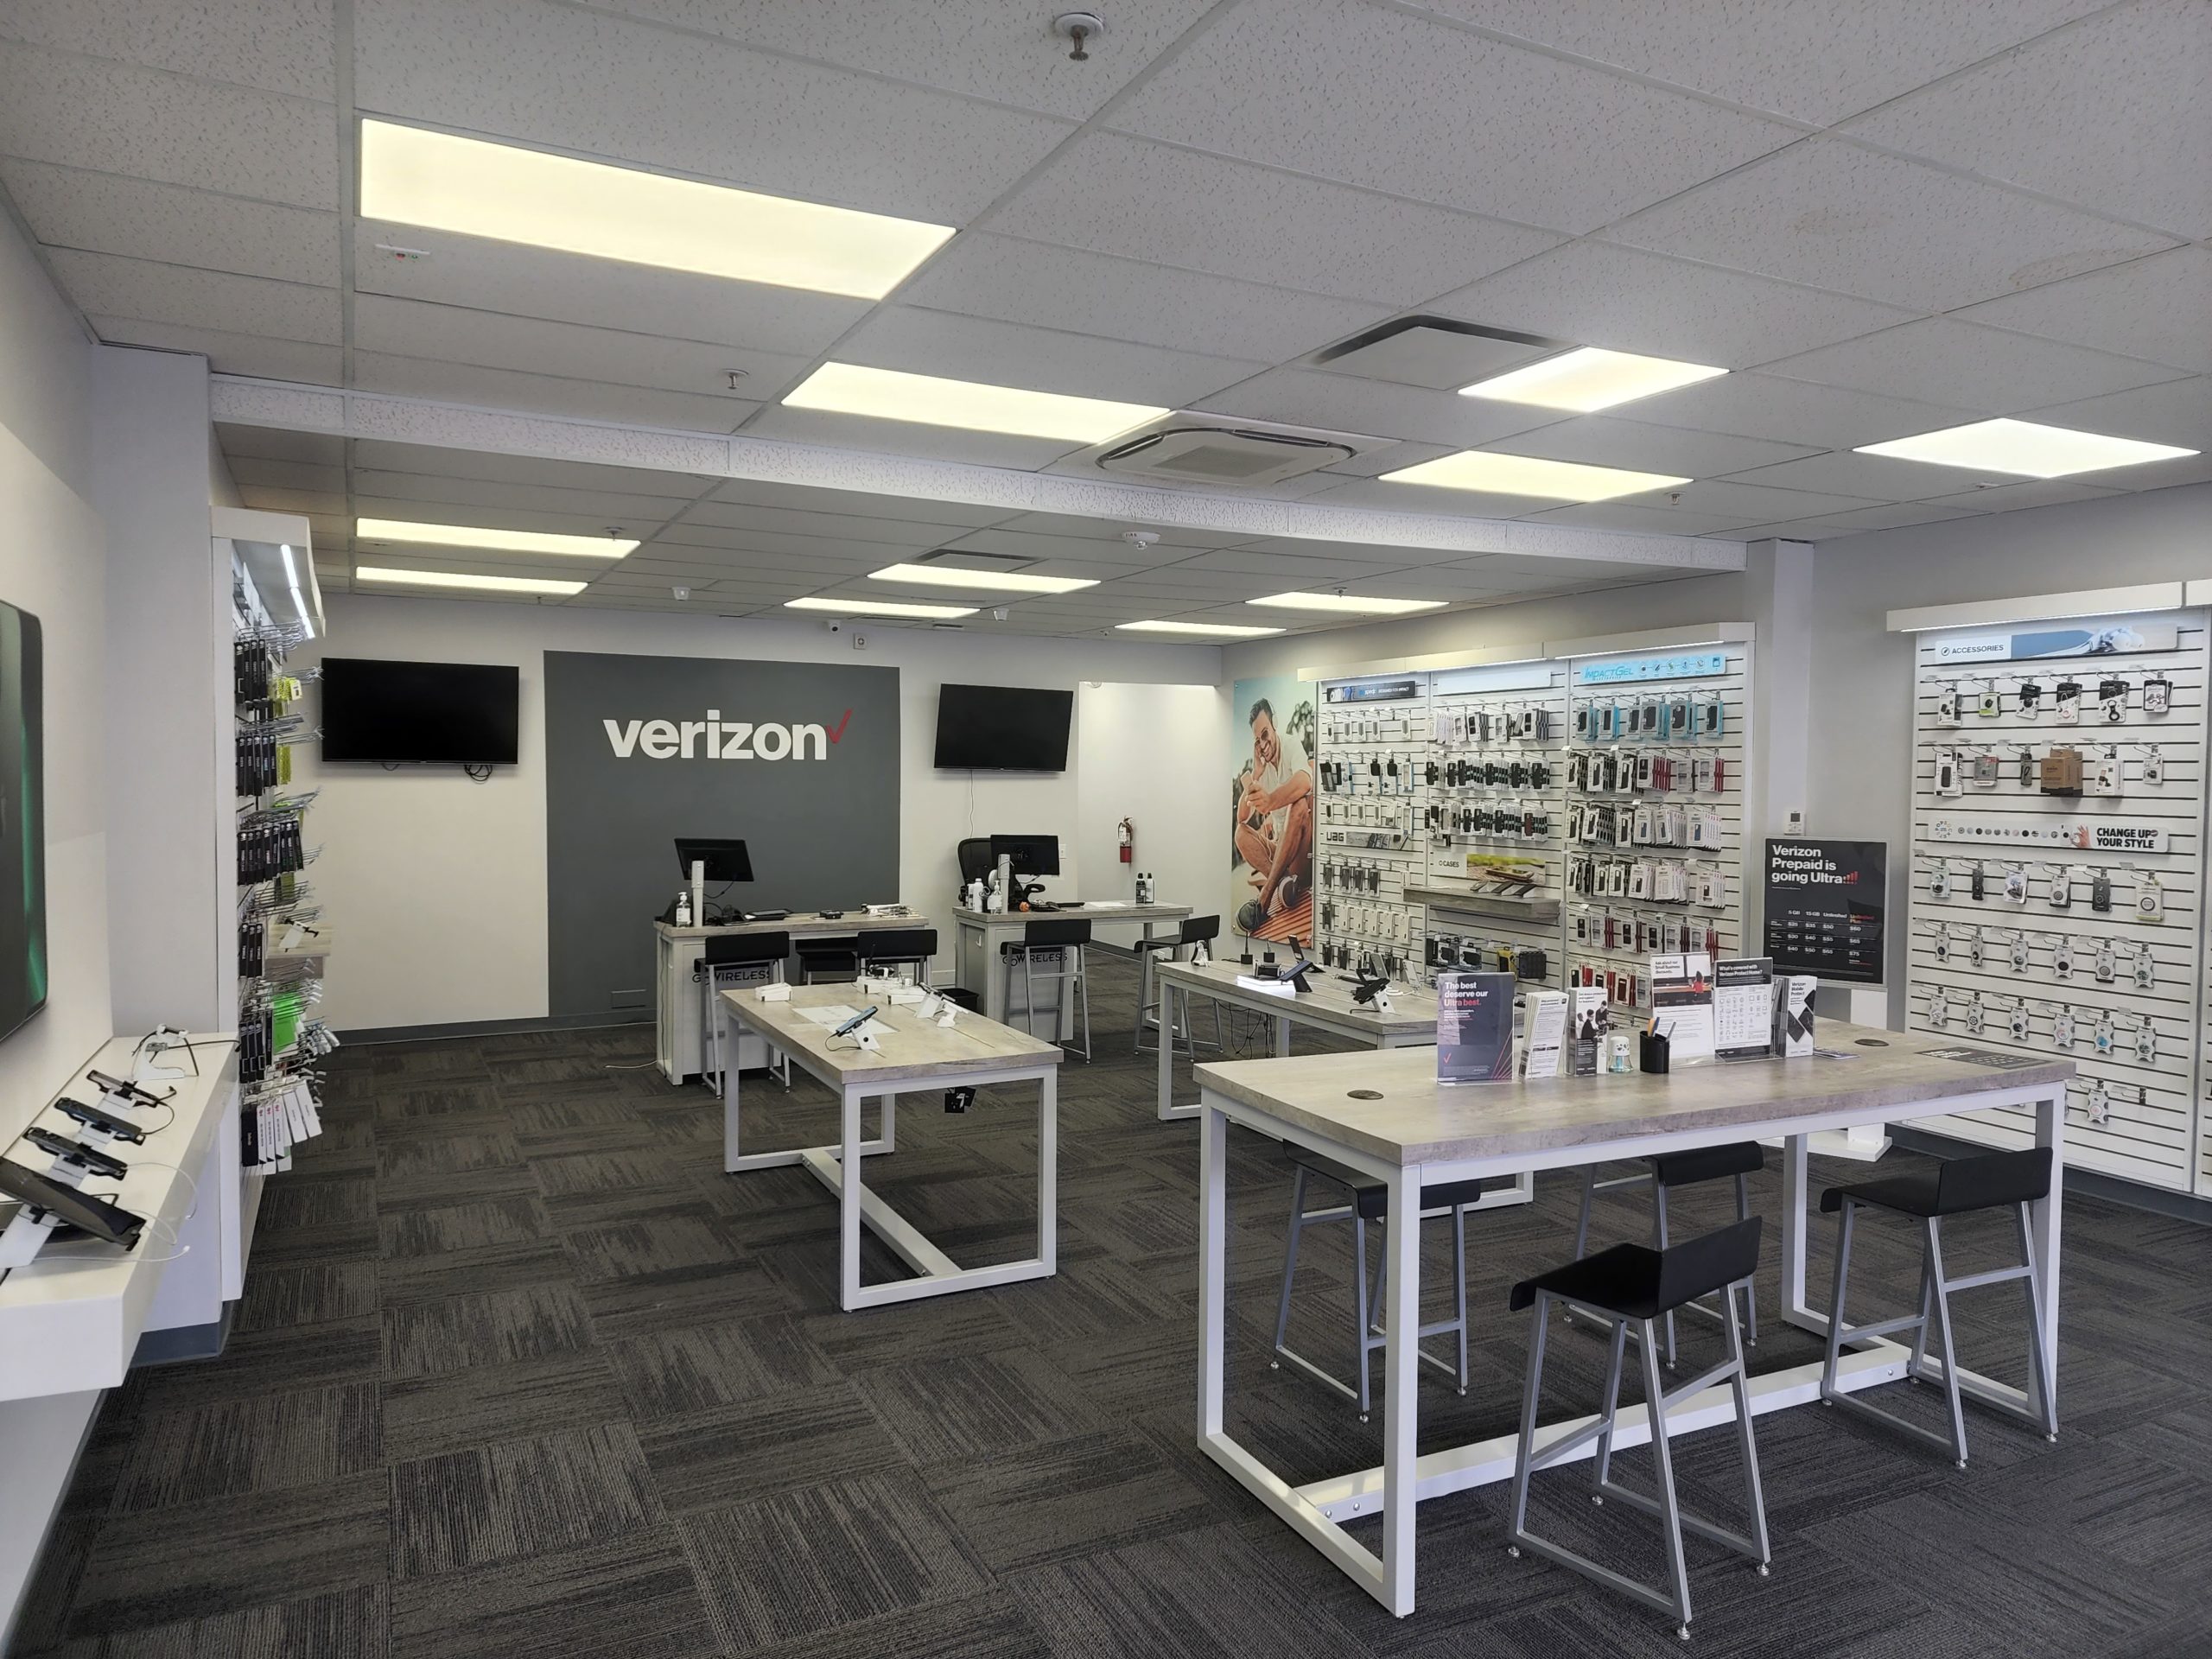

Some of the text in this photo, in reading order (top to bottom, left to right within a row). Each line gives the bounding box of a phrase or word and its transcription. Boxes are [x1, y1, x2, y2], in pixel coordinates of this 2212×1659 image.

[1952, 643, 2005, 655] ACCESSORIES
[602, 709, 827, 761] verizon
[2097, 827, 2152, 839] CHANGE UP
[2096, 837, 2155, 849] YOUR STYLE
[1772, 844, 1821, 857] Verizon
[1443, 860, 1460, 868] CASES
[1771, 857, 1837, 871] Prepaid is
[1771, 870, 1843, 885] going Ultra
[1002, 953, 1068, 967] GOWRELES
[1444, 998, 1482, 1007] Ultra best.
